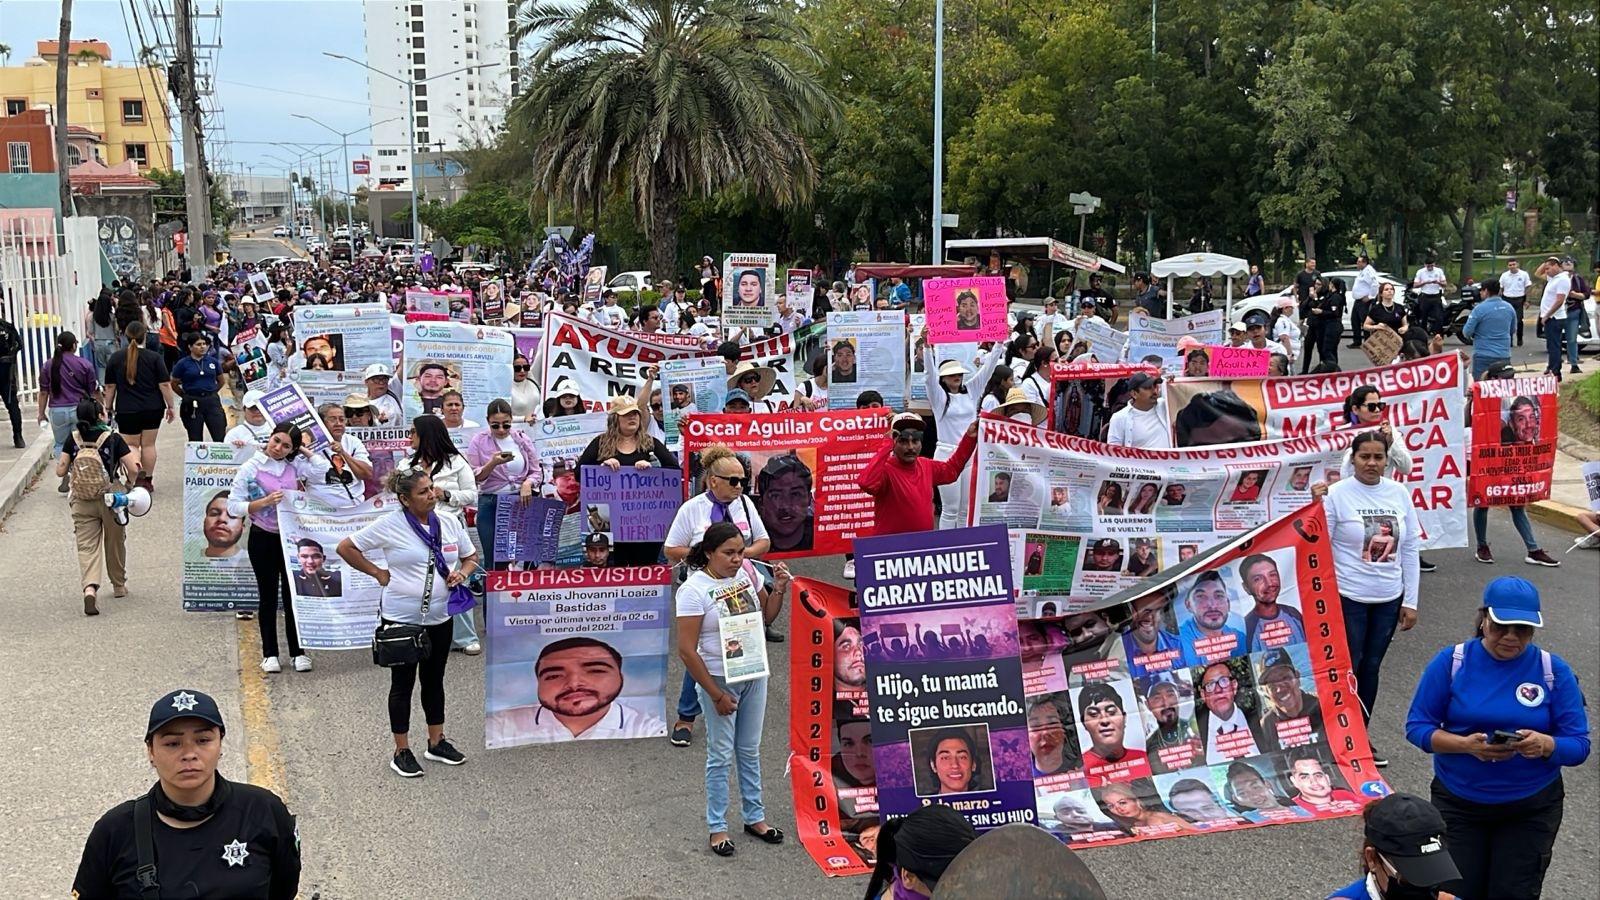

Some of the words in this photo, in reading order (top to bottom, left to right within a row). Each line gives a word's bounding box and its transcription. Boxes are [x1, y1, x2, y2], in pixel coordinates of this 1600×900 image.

[429, 331, 452, 339] Sinaloa
[1222, 348, 1265, 359] OSCAR
[552, 352, 576, 370] A
[1216, 358, 1260, 369] AGUILAR
[1054, 363, 1083, 372] Oscar
[1276, 362, 1451, 404] DESAPARECIDO
[557, 425, 581, 433] Sinaloa
[689, 420, 742, 436] Oscar
[748, 420, 813, 438] Aguilar
[820, 413, 889, 432] Coatzin
[1281, 416, 1317, 439] MI
[689, 440, 717, 448] Privado
[735, 439, 761, 447] libertad
[761, 436, 828, 447] 09/Diciembre/2024
[836, 433, 864, 442] Mazatlán
[983, 420, 1045, 448] HASTA
[1240, 441, 1278, 458] UNO
[1283, 437, 1316, 454] SON
[210, 452, 233, 460] Sinaloa
[541, 449, 565, 458] CARLOS
[824, 455, 831, 463] En
[197, 465, 237, 476] Ayúdanos
[1437, 454, 1462, 479] A
[185, 477, 215, 487] PABLO
[585, 468, 612, 491] Hoy
[586, 491, 602, 501] con
[621, 489, 664, 500] HERMANA
[621, 502, 643, 511] PERO
[298, 525, 328, 533] MIGUEL
[874, 550, 990, 580] EMMANUEL
[493, 571, 534, 591] ¿LO
[539, 568, 584, 585] HAS
[590, 566, 665, 583] VISTO?
[527, 591, 562, 602] Alexis
[564, 589, 619, 601] Jhovanni
[620, 588, 658, 599] Loaiza
[863, 581, 928, 608] GARAY
[930, 574, 1008, 601] BERNAL
[555, 603, 607, 613] Bastidas
[509, 616, 535, 625] Visto
[535, 617, 553, 626] por
[554, 615, 584, 624] última
[612, 613, 627, 621] día
[628, 613, 641, 621] 02
[642, 613, 655, 621] de
[545, 625, 574, 633] enero
[575, 624, 590, 632] del
[591, 624, 619, 632] 2021.
[876, 675, 919, 700] Hijo,
[921, 674, 941, 692] tu
[944, 667, 998, 690] mamá
[877, 706, 895, 723] te
[898, 701, 939, 726] sigue
[942, 695, 1024, 719] buscando.
[952, 799, 990, 811] marzo
[973, 813, 990, 825] SIN
[992, 812, 1006, 824] SU
[1007, 809, 1034, 823] HIJO
